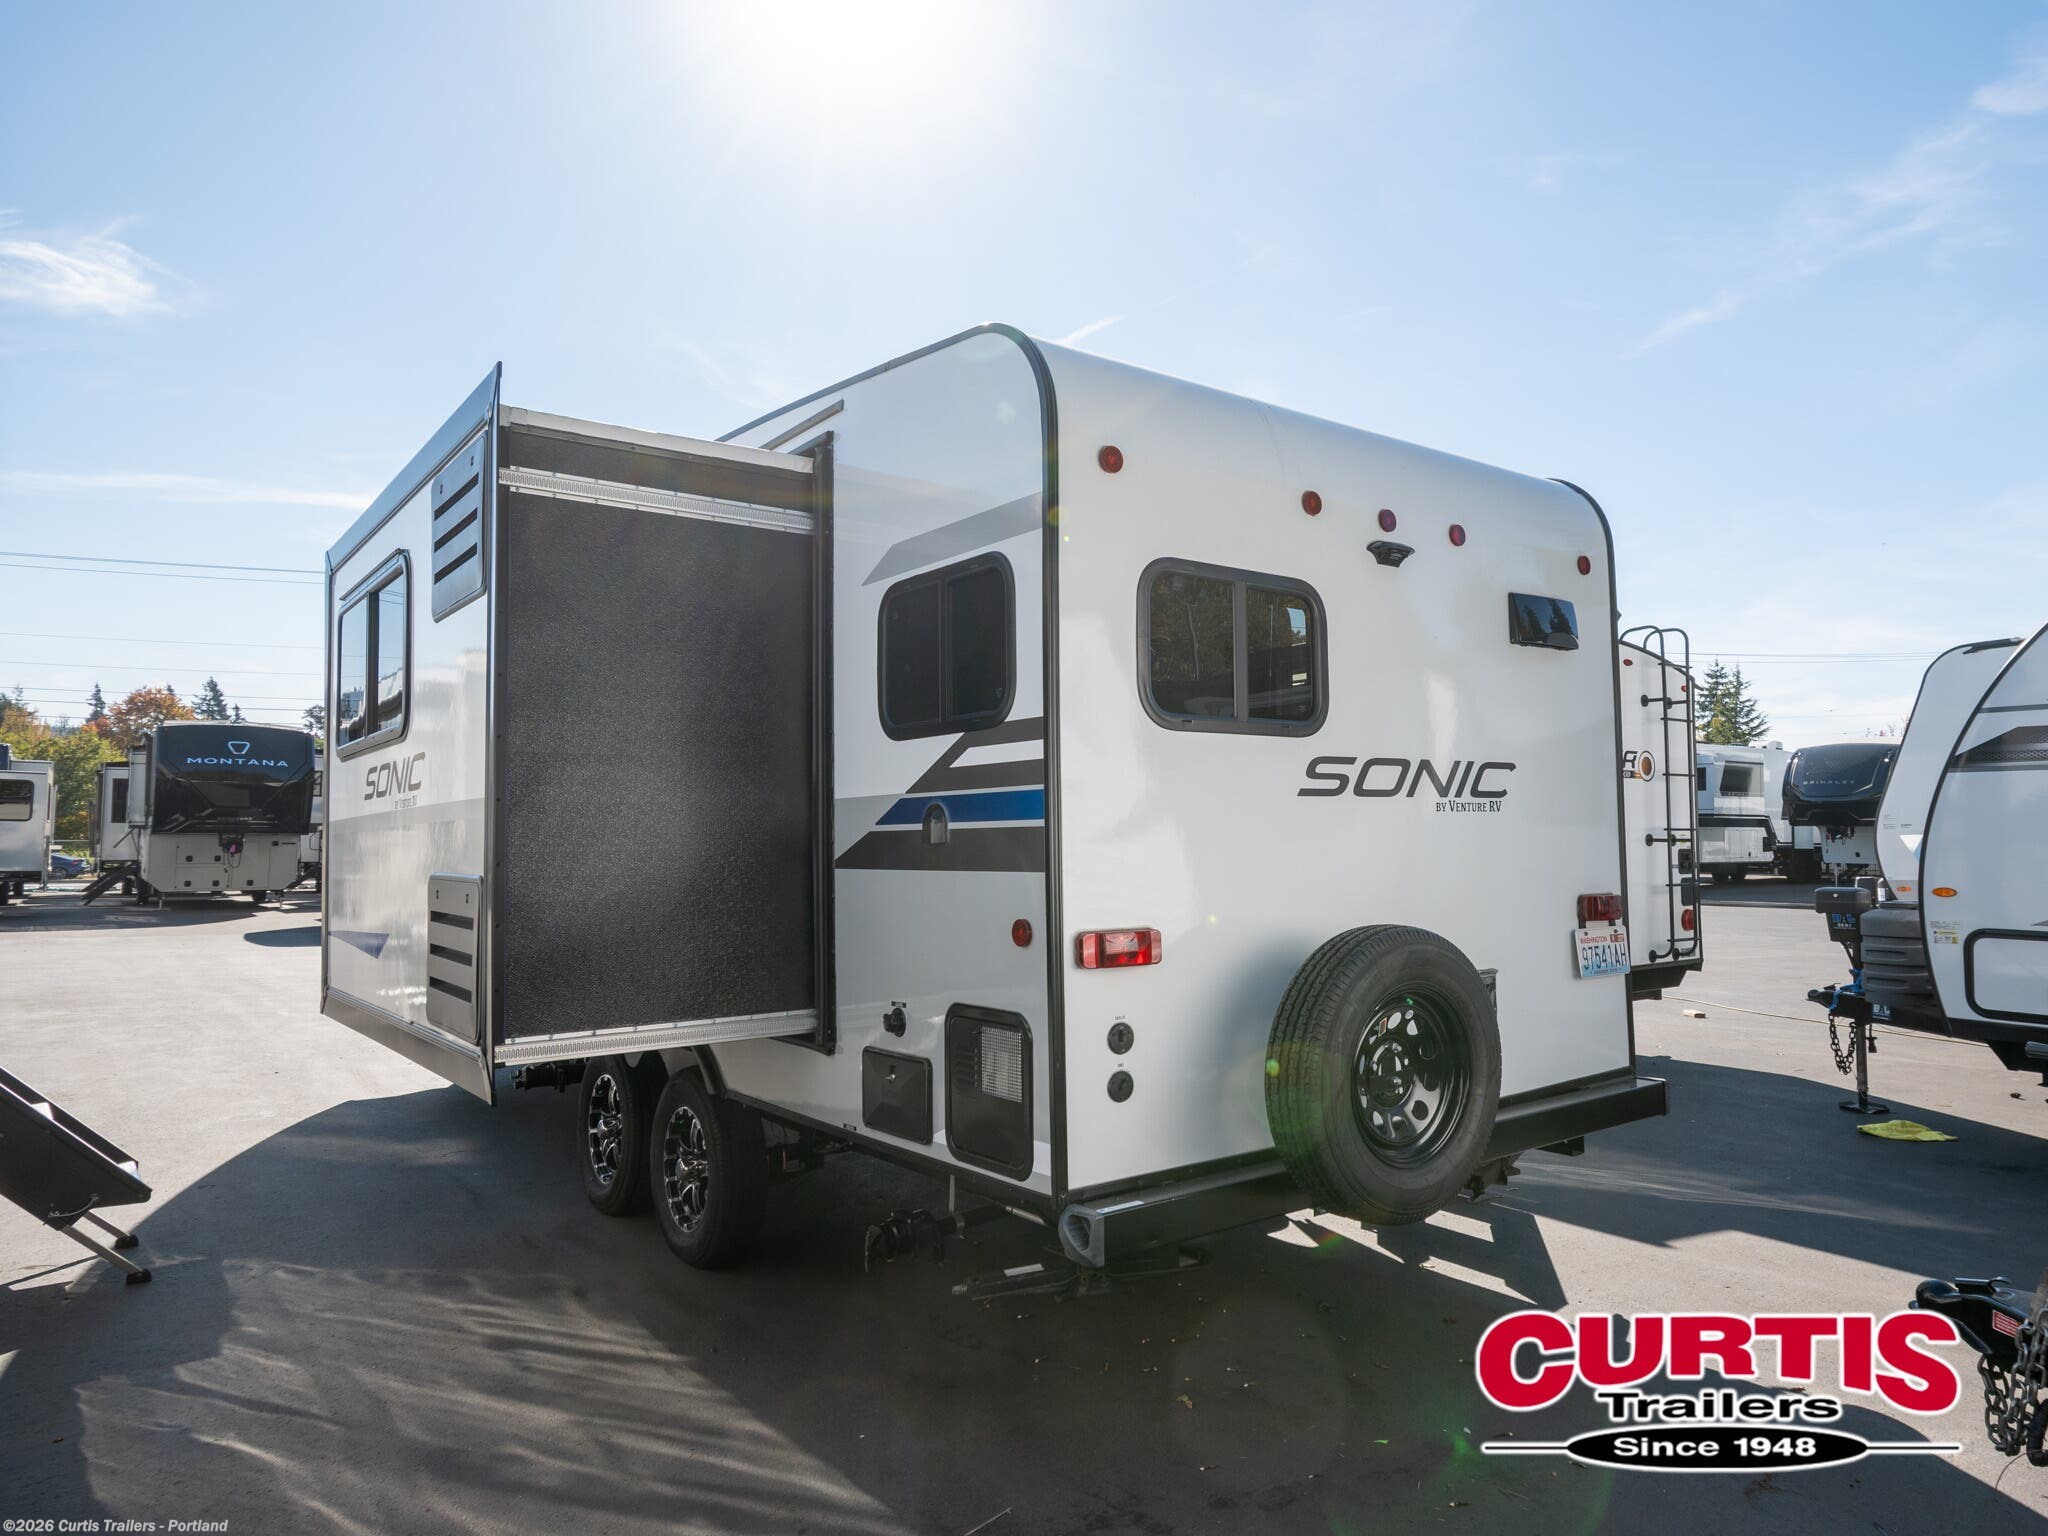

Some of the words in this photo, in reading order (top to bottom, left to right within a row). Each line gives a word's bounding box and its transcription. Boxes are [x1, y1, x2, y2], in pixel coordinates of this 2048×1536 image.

[186, 757, 289, 768] MONTANA
[364, 752, 426, 801] SONIC
[1297, 756, 1517, 799] SONIC
[1436, 802, 1447, 813] BY
[1449, 800, 1488, 813] VENTURE
[1489, 800, 1503, 813] RV
